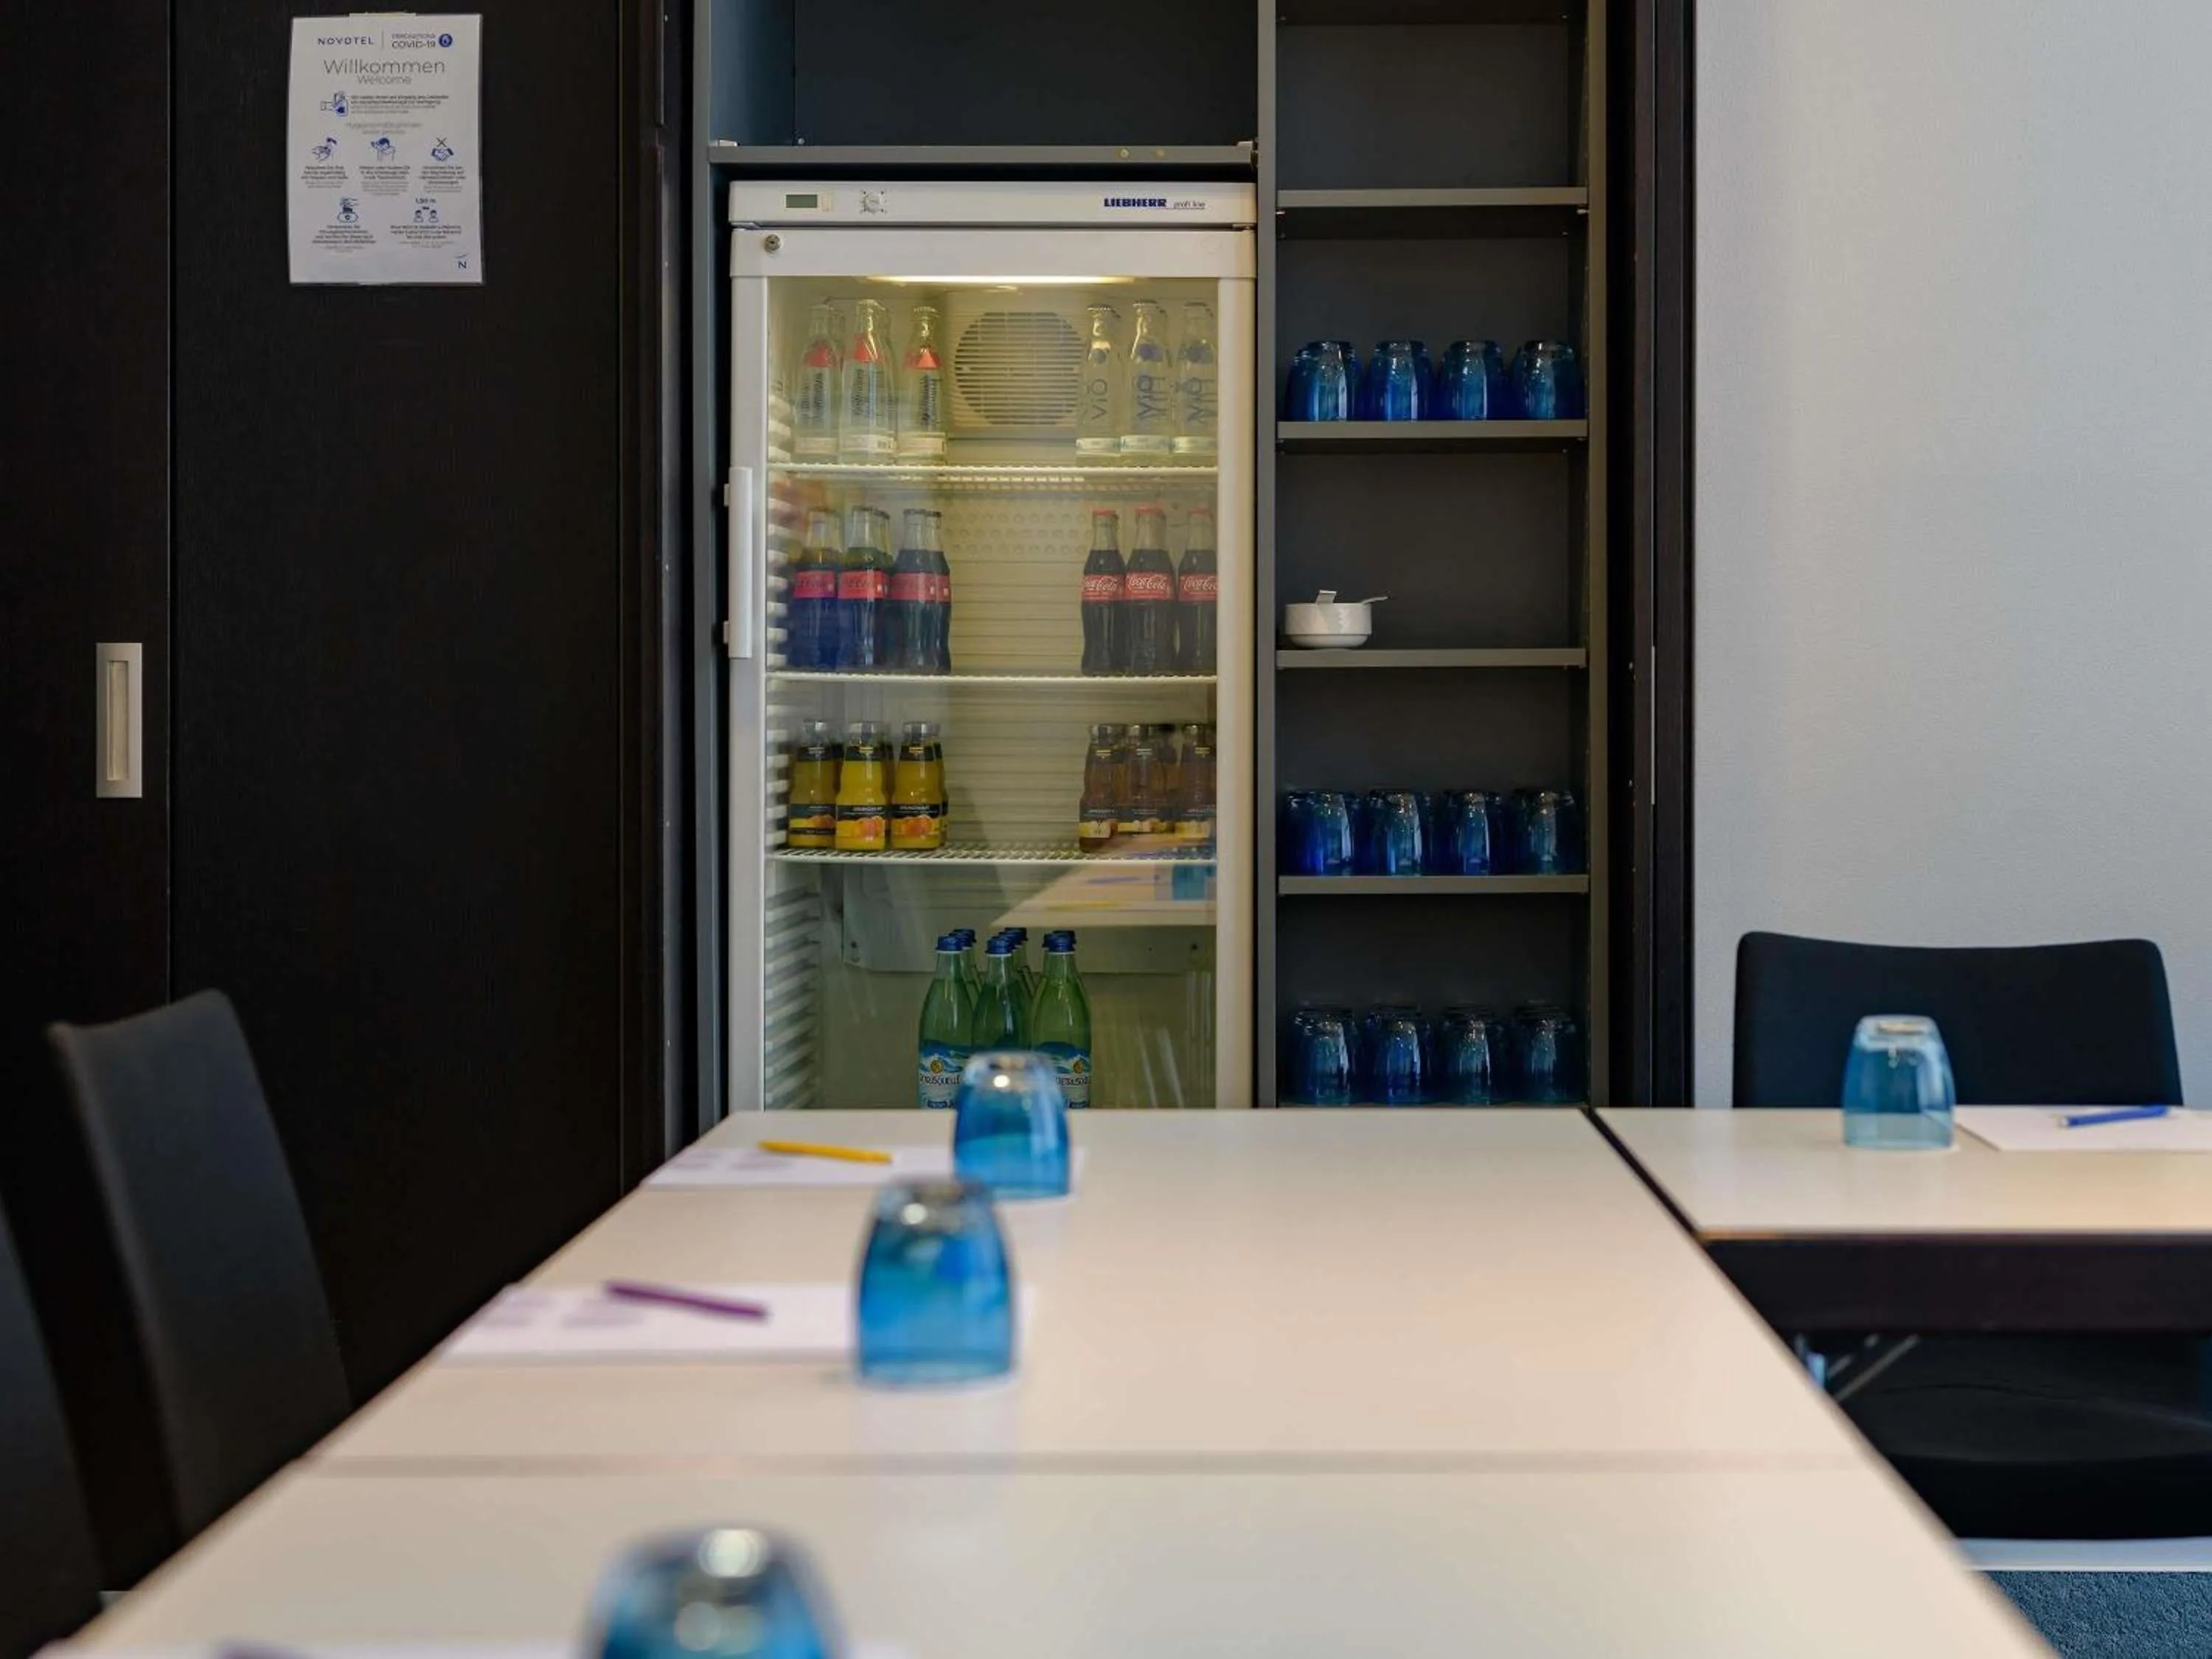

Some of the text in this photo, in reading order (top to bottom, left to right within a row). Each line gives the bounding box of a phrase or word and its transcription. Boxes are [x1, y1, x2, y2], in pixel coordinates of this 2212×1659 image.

[318, 36, 375, 46] NOVOTEL
[391, 40, 437, 49] COVID-19
[323, 58, 445, 74] Willkommen
[357, 75, 411, 86] Welcome
[1104, 198, 1167, 207] LIEBHERR
